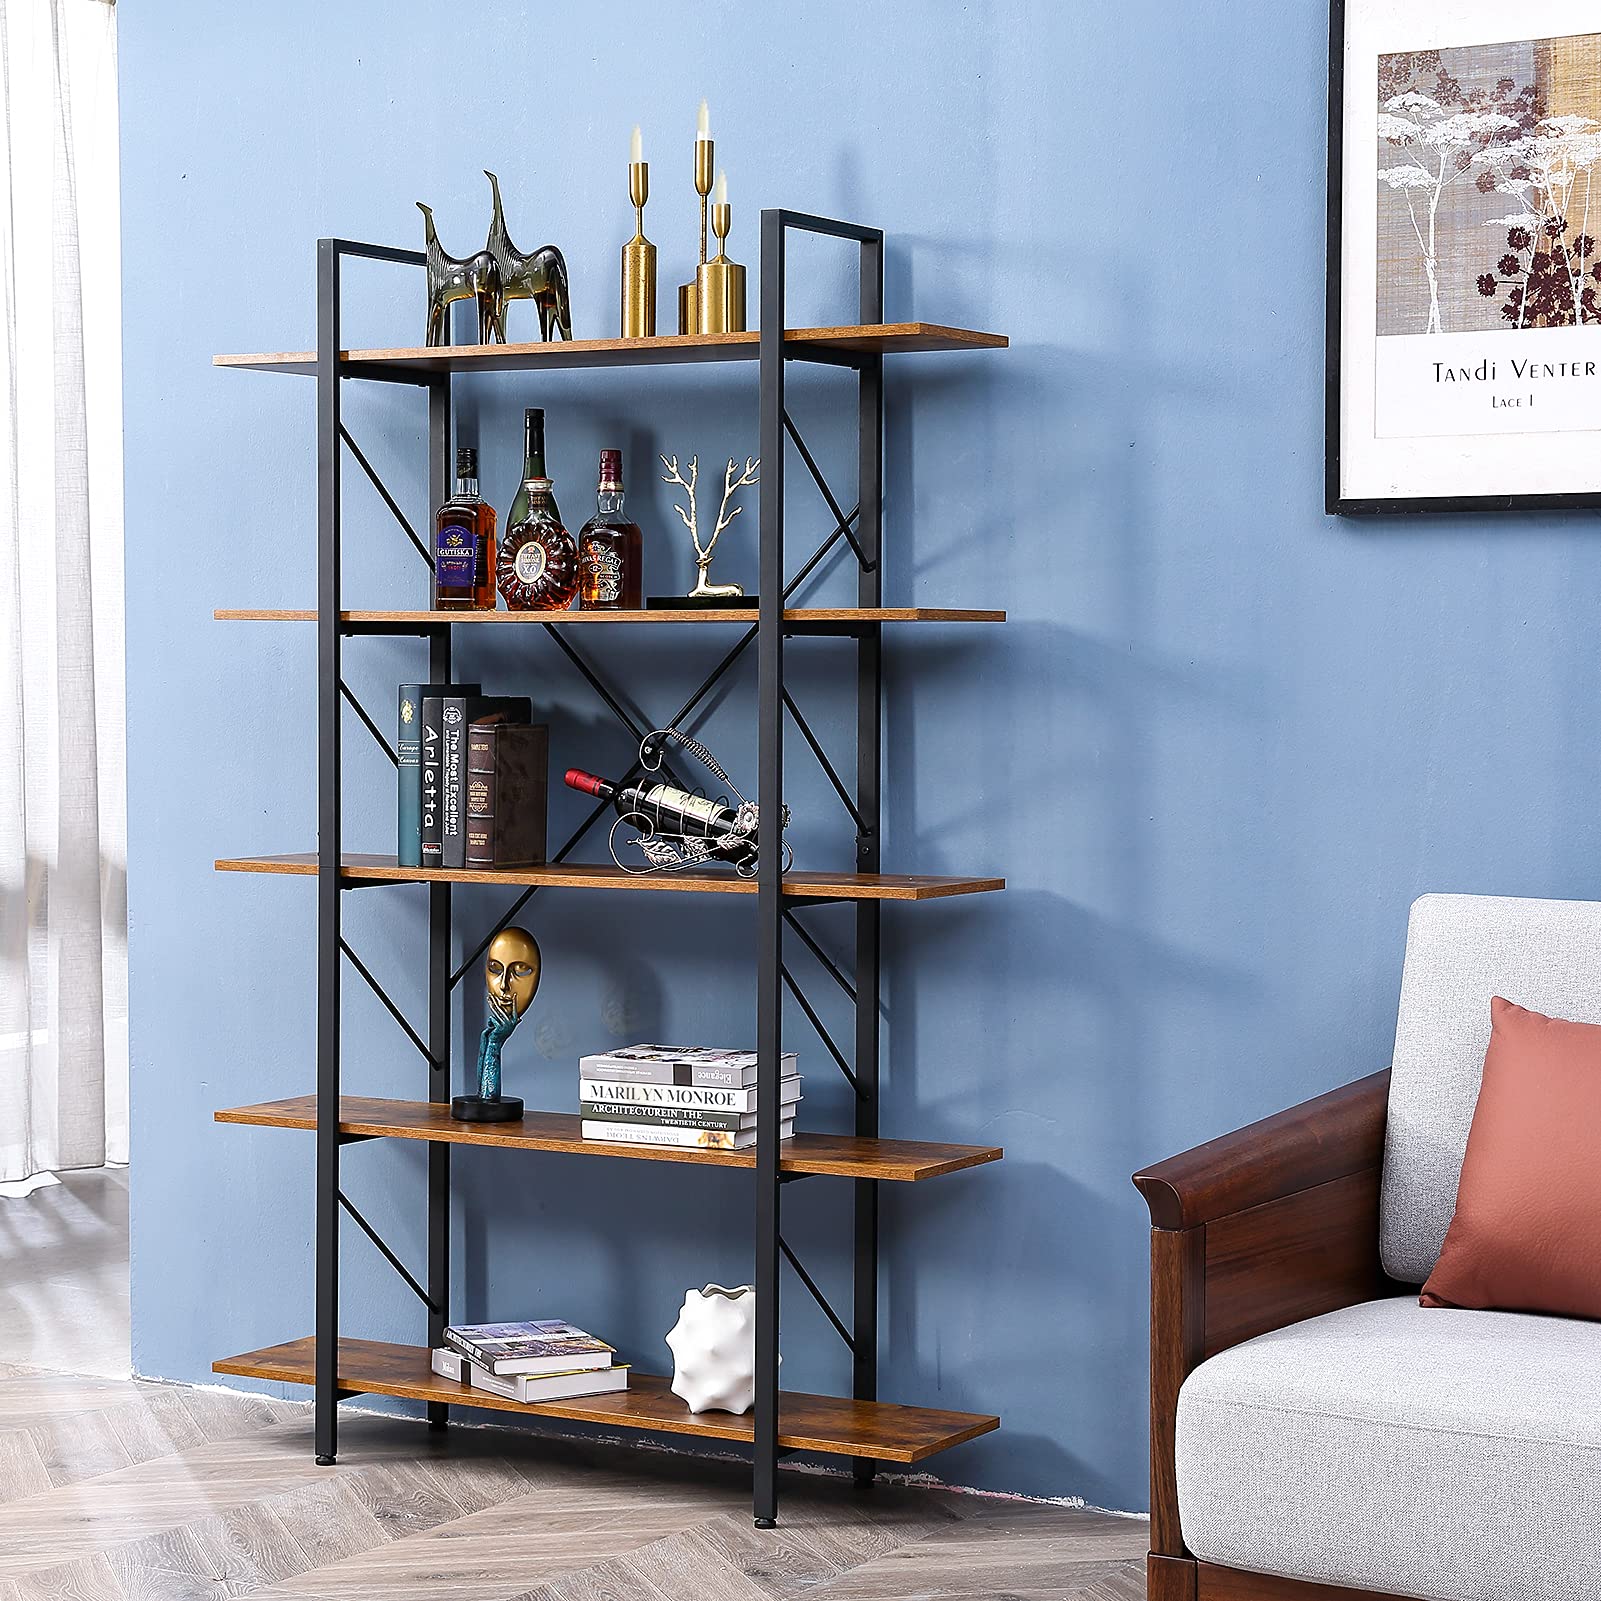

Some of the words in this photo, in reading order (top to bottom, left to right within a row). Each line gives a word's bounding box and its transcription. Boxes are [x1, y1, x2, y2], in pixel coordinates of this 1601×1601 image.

[449, 729, 460, 751] The
[424, 725, 439, 828] Arletta
[449, 753, 460, 782] Most
[449, 784, 460, 836] Excellent
[697, 1069, 733, 1084] Elegance
[590, 1085, 665, 1102] MARILYN
[668, 1089, 736, 1107] MONROE
[681, 1110, 703, 1120] THE
[698, 1121, 728, 1129] CENTURY
